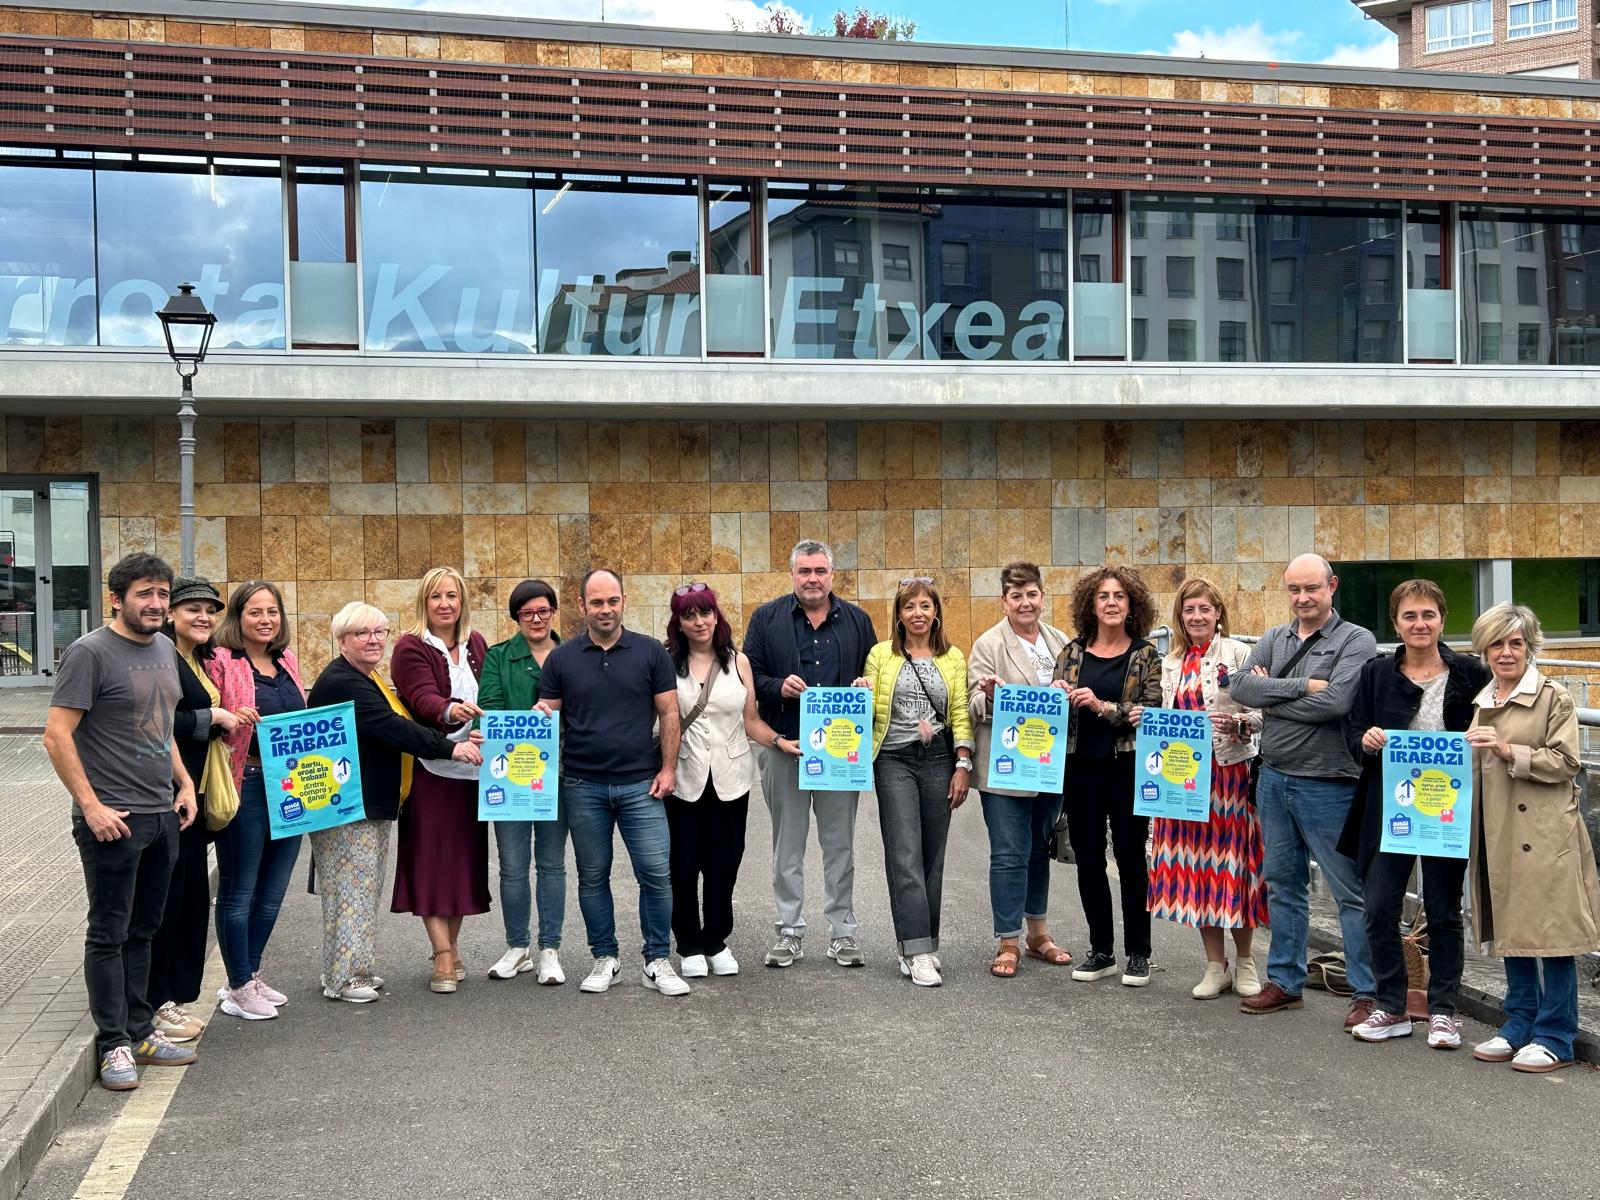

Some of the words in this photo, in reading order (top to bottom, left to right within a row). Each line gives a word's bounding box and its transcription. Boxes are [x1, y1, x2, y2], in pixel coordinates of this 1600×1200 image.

[366, 262, 701, 356] Kultur
[774, 276, 1065, 361] Etxea
[904, 665, 937, 674] DEAM
[806, 692, 866, 703] 2.500€
[1000, 689, 1062, 704] 2.500€
[806, 704, 866, 715] IRABAZI
[1000, 701, 1062, 715] IRABAZI
[487, 716, 552, 728] 2.500€
[1143, 712, 1205, 728] 2.500€
[270, 717, 345, 742] 2.500€
[487, 728, 552, 739] IRABAZI
[1143, 725, 1205, 740] IRABAZI
[271, 732, 347, 757] IRABAZI
[1389, 736, 1463, 752] 2.500€
[1390, 751, 1464, 766] IRABAZI
